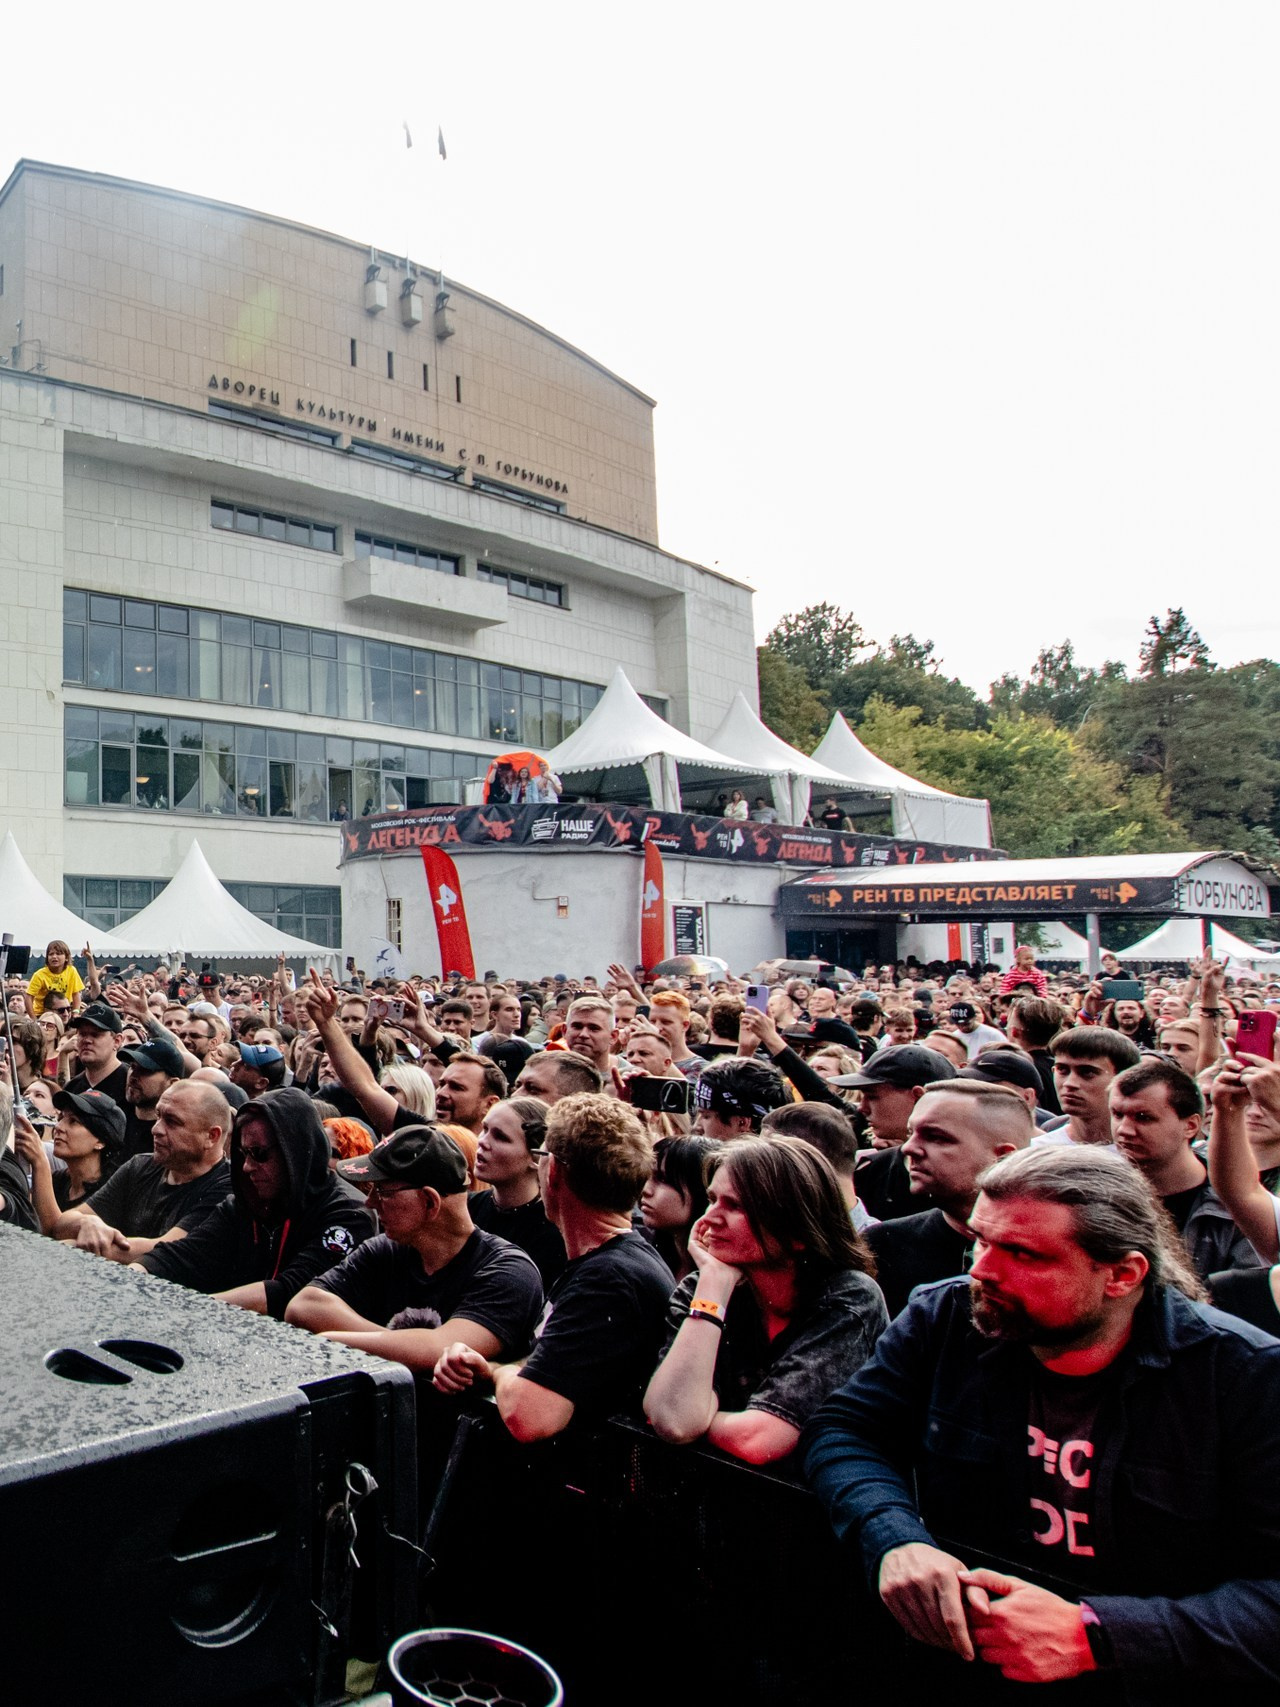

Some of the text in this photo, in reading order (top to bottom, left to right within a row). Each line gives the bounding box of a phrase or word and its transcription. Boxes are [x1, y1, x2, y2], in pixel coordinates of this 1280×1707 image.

[208, 373, 569, 494] ДВОРЕЦ КУЛЬТУРЫ ИМЕНИ С. П. ГОРБУНОВА
[367, 823, 463, 850] ЛЕГЕНДА
[561, 819, 594, 832] НАШЕ
[561, 832, 588, 840] РАДИО
[777, 841, 833, 863] ЛЕГЕНДА
[853, 884, 1077, 906] РЕН ТВ ПРЕДСТАВЛЯЕТ
[1187, 879, 1265, 912] ГОРБУНОВА
[695, 916, 703, 954] ВГУСТА
